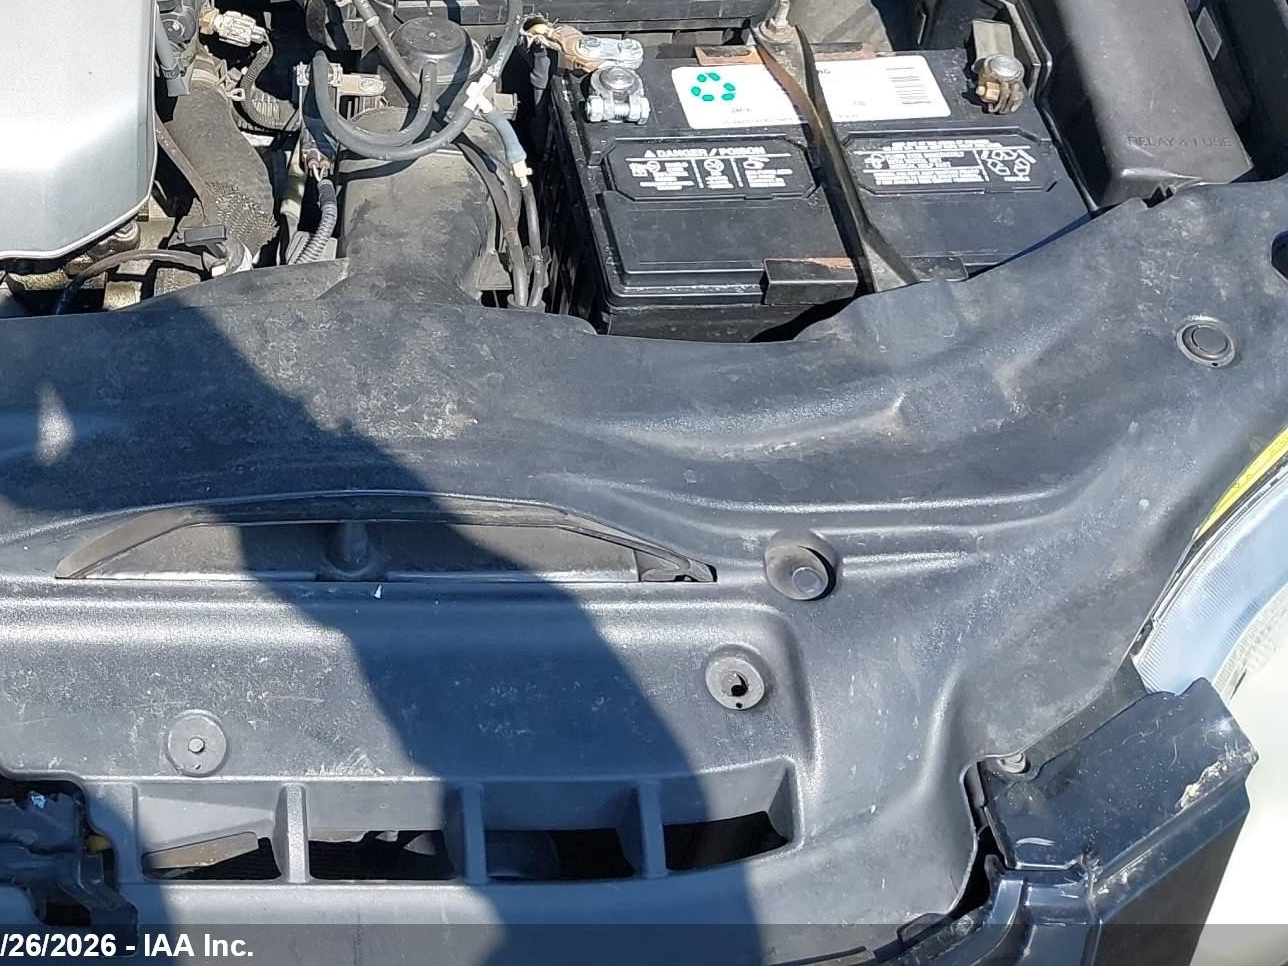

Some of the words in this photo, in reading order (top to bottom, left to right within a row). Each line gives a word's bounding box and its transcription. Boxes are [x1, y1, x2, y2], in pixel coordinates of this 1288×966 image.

[1127, 136, 1175, 147] RELAY
[656, 147, 710, 158] DANGER
[718, 146, 767, 156] POISON
